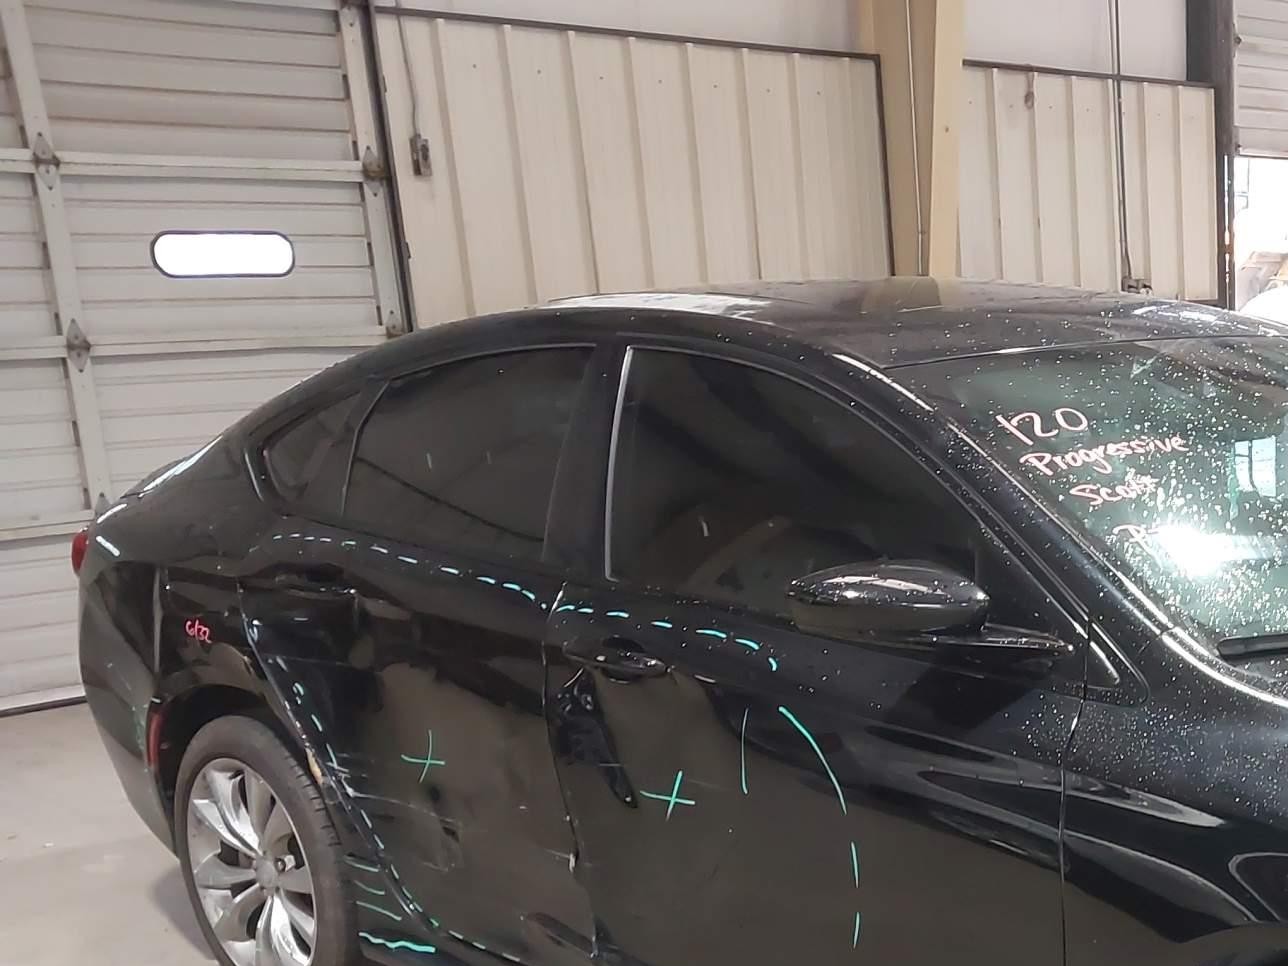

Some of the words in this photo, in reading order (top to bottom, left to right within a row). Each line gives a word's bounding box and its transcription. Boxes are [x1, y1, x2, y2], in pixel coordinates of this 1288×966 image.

[996, 407, 1088, 446] 120
[1019, 434, 1189, 476] Progressive
[185, 619, 212, 644] 6/32
